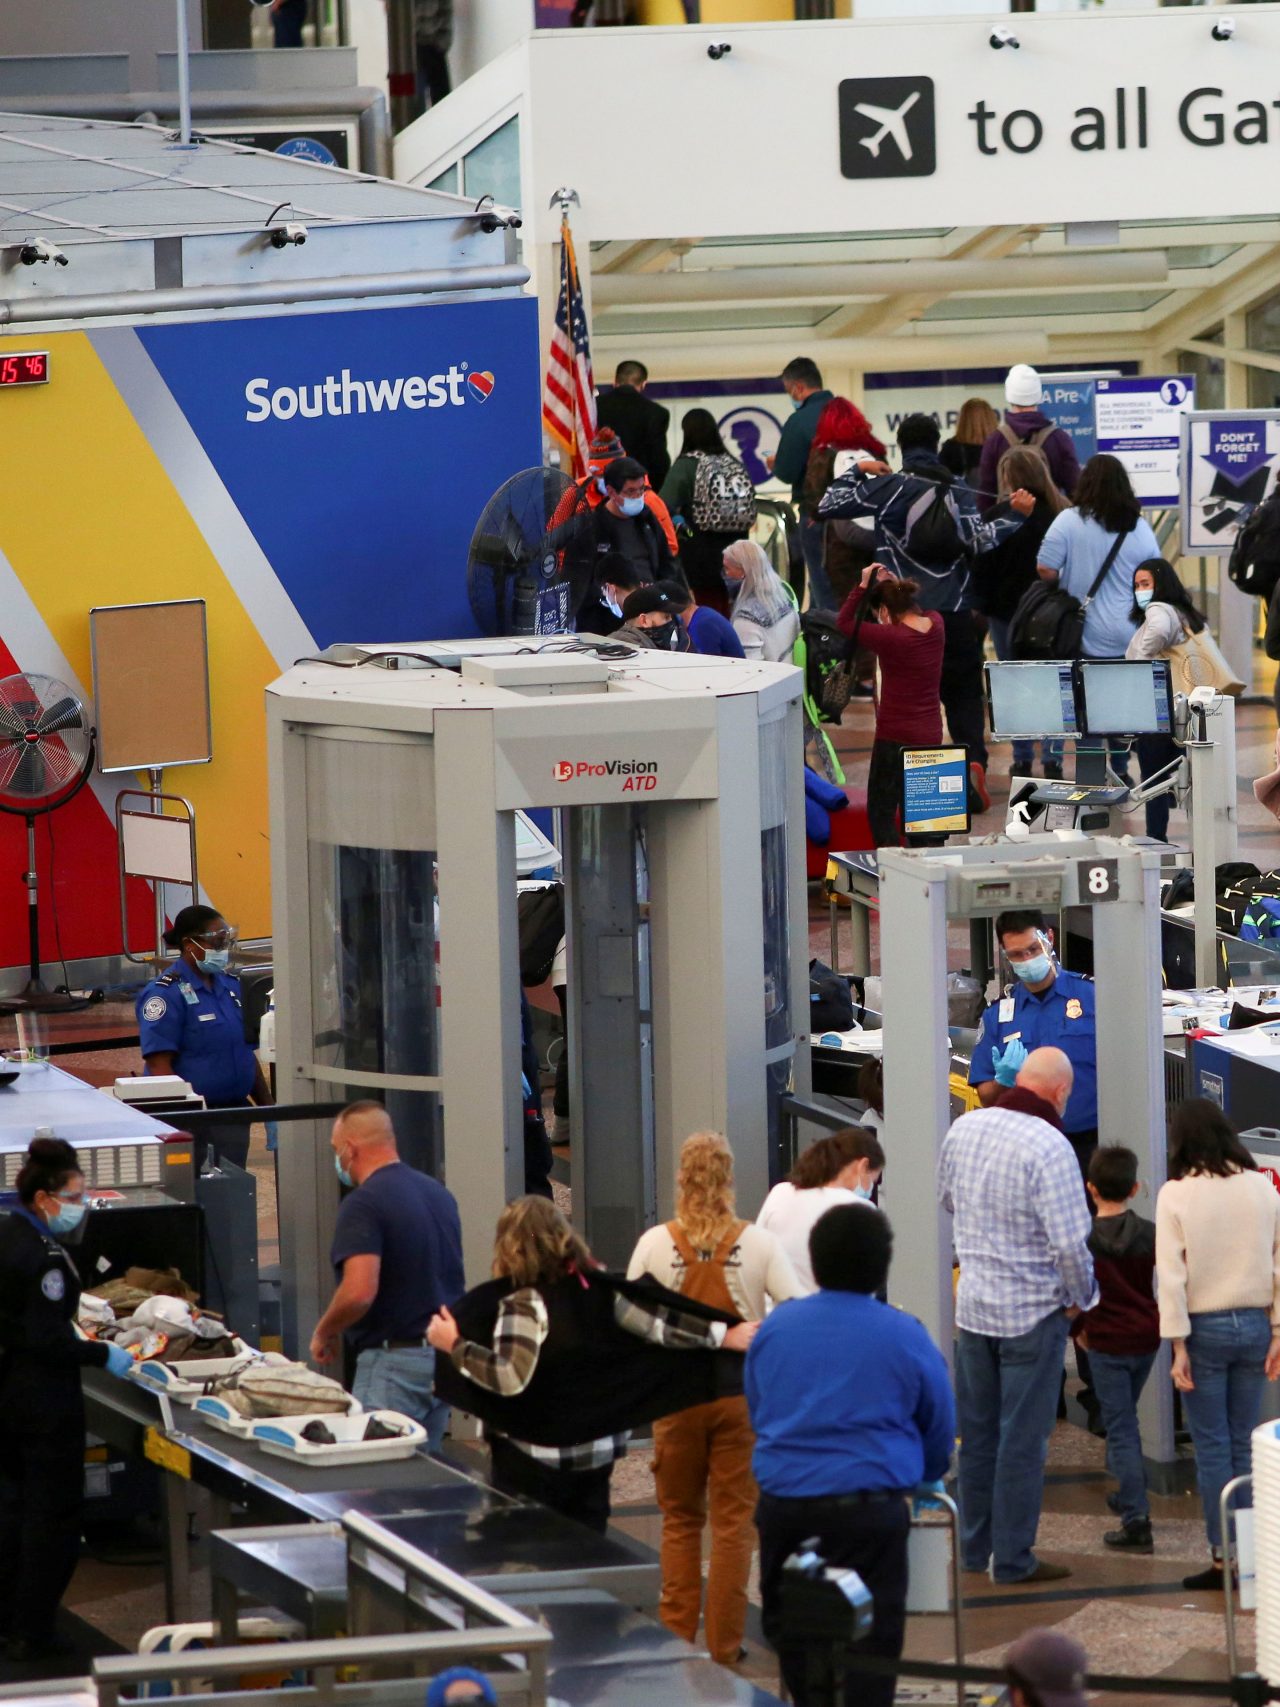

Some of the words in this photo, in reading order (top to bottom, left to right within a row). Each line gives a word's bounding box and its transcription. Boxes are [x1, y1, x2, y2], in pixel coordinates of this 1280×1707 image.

[967, 100, 1043, 155] to
[1070, 86, 1147, 152] all
[1, 357, 18, 383] 15
[26, 355, 43, 375] 46
[245, 365, 466, 422] Southwest
[1220, 432, 1255, 442] DON'T
[1215, 443, 1260, 453] FORGET
[1228, 454, 1247, 463] ME!
[576, 759, 658, 777] ProVision
[622, 775, 657, 792] ATD
[1088, 866, 1109, 894] 8
